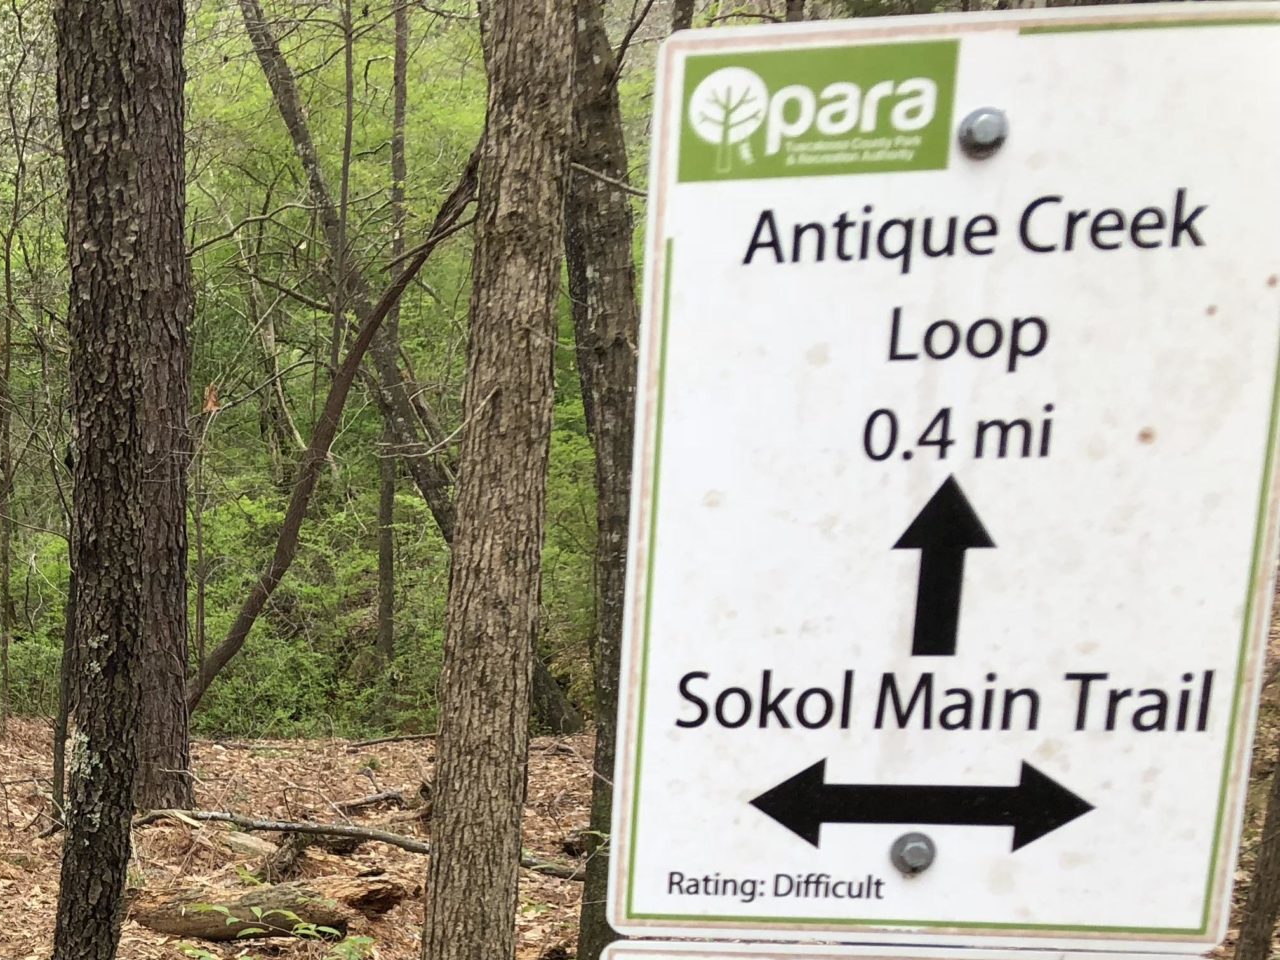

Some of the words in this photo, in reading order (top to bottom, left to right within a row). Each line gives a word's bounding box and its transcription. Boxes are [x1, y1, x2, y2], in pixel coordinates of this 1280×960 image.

[764, 76, 938, 157] para
[851, 137, 891, 151] County
[893, 135, 922, 147] Park
[861, 149, 914, 162] Authority
[742, 205, 999, 275] Antique
[1018, 188, 1205, 253] Creek
[888, 307, 1049, 373] Loop
[863, 407, 955, 462] 0.4
[974, 403, 1054, 459] mi
[675, 669, 854, 730] Sokol
[873, 672, 1040, 731] Main
[1064, 669, 1214, 733] Trail
[667, 871, 767, 903] Rating:
[773, 872, 886, 900] Difficult
